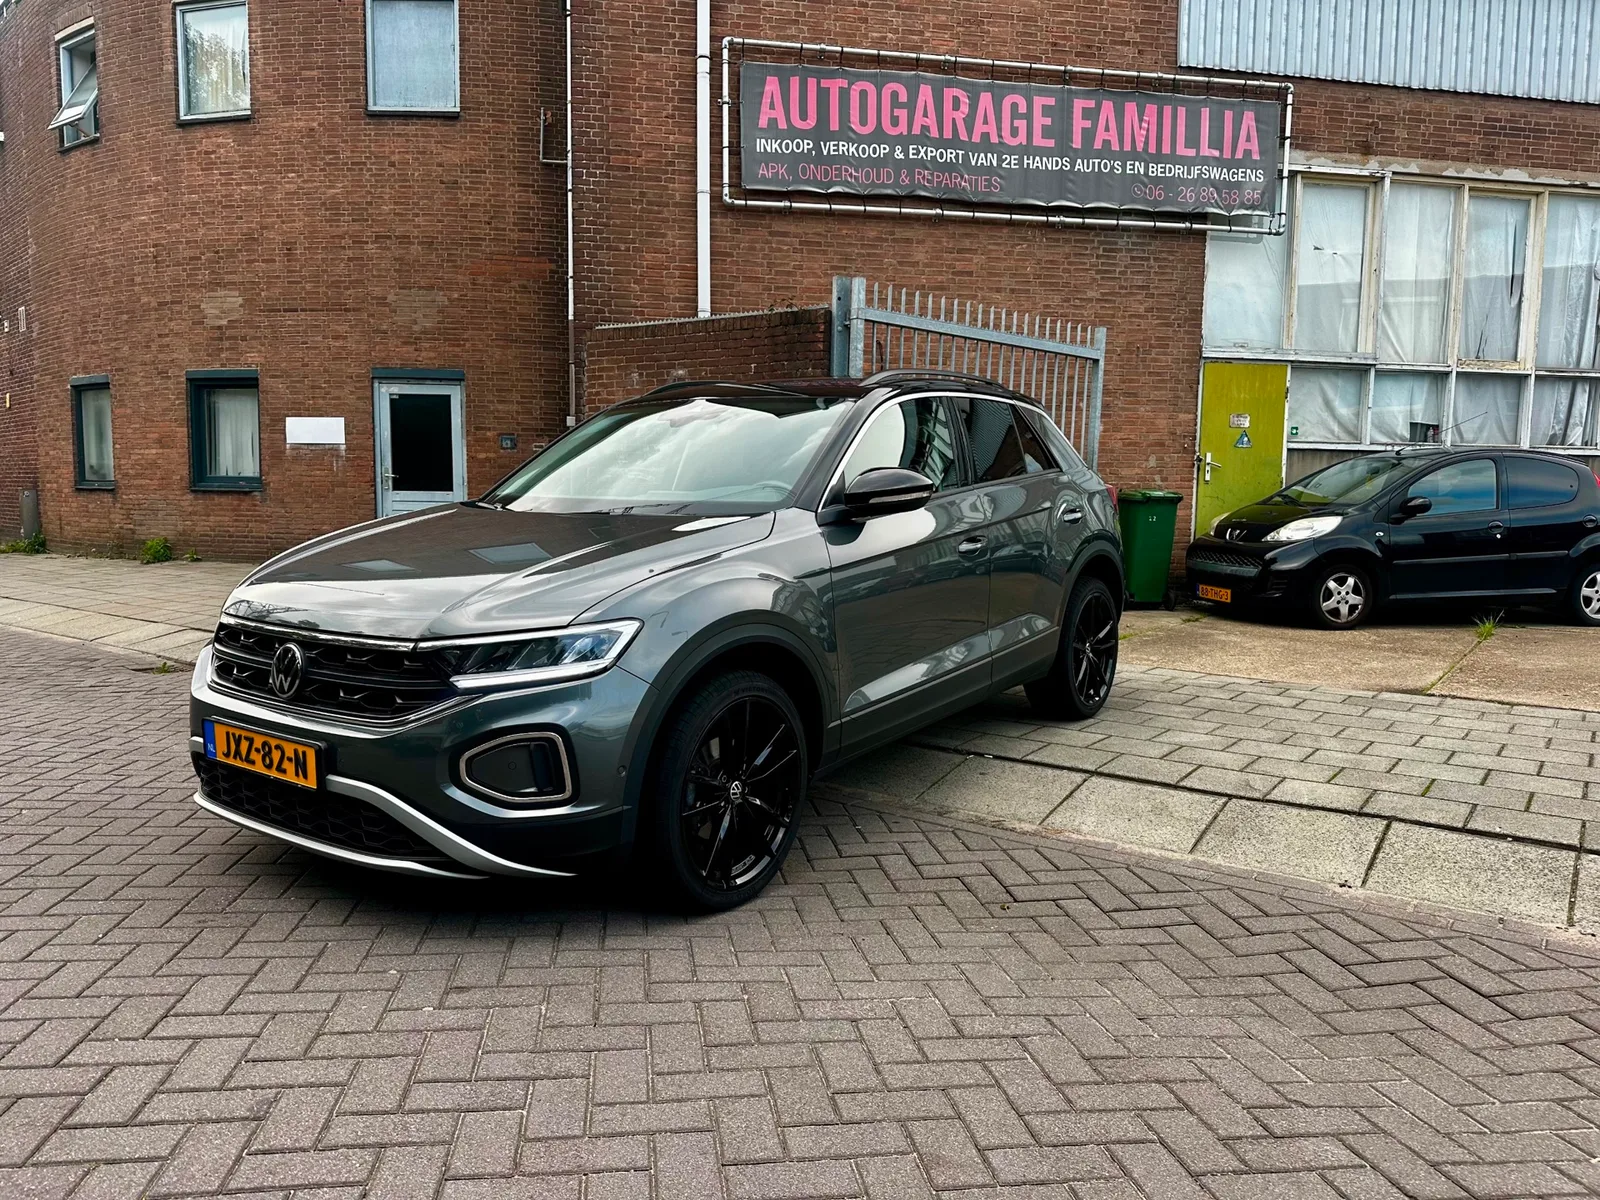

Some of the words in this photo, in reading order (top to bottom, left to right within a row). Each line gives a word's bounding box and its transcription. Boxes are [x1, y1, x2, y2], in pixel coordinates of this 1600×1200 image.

[757, 75, 1056, 148] AUTOGARAGE
[1072, 97, 1261, 160] FAMILLIA
[756, 137, 816, 157] INKOOP,
[820, 140, 890, 159] VERKOOP
[895, 146, 905, 160] &
[909, 145, 965, 164] EXPORT
[969, 152, 998, 168] VAN
[1001, 154, 1019, 169] 2E
[1023, 155, 1071, 172] HANDS
[1074, 158, 1122, 174] AUTO'S
[1126, 161, 1145, 175] EN
[1149, 163, 1264, 183] BEDRIJFSWAGENS
[758, 162, 793, 181] APK,
[798, 163, 894, 185] ONDERHOUD
[899, 168, 910, 185] &
[915, 168, 1001, 193] REPARATIES
[1146, 184, 1165, 201] 06
[1177, 186, 1195, 203] 26
[1199, 186, 1217, 203] 89
[1221, 189, 1239, 205] 58
[1243, 189, 1261, 206] 85
[1200, 586, 1229, 601] 88-THG-3
[207, 742, 216, 753] NL
[221, 730, 309, 781] JXZ-82-N
